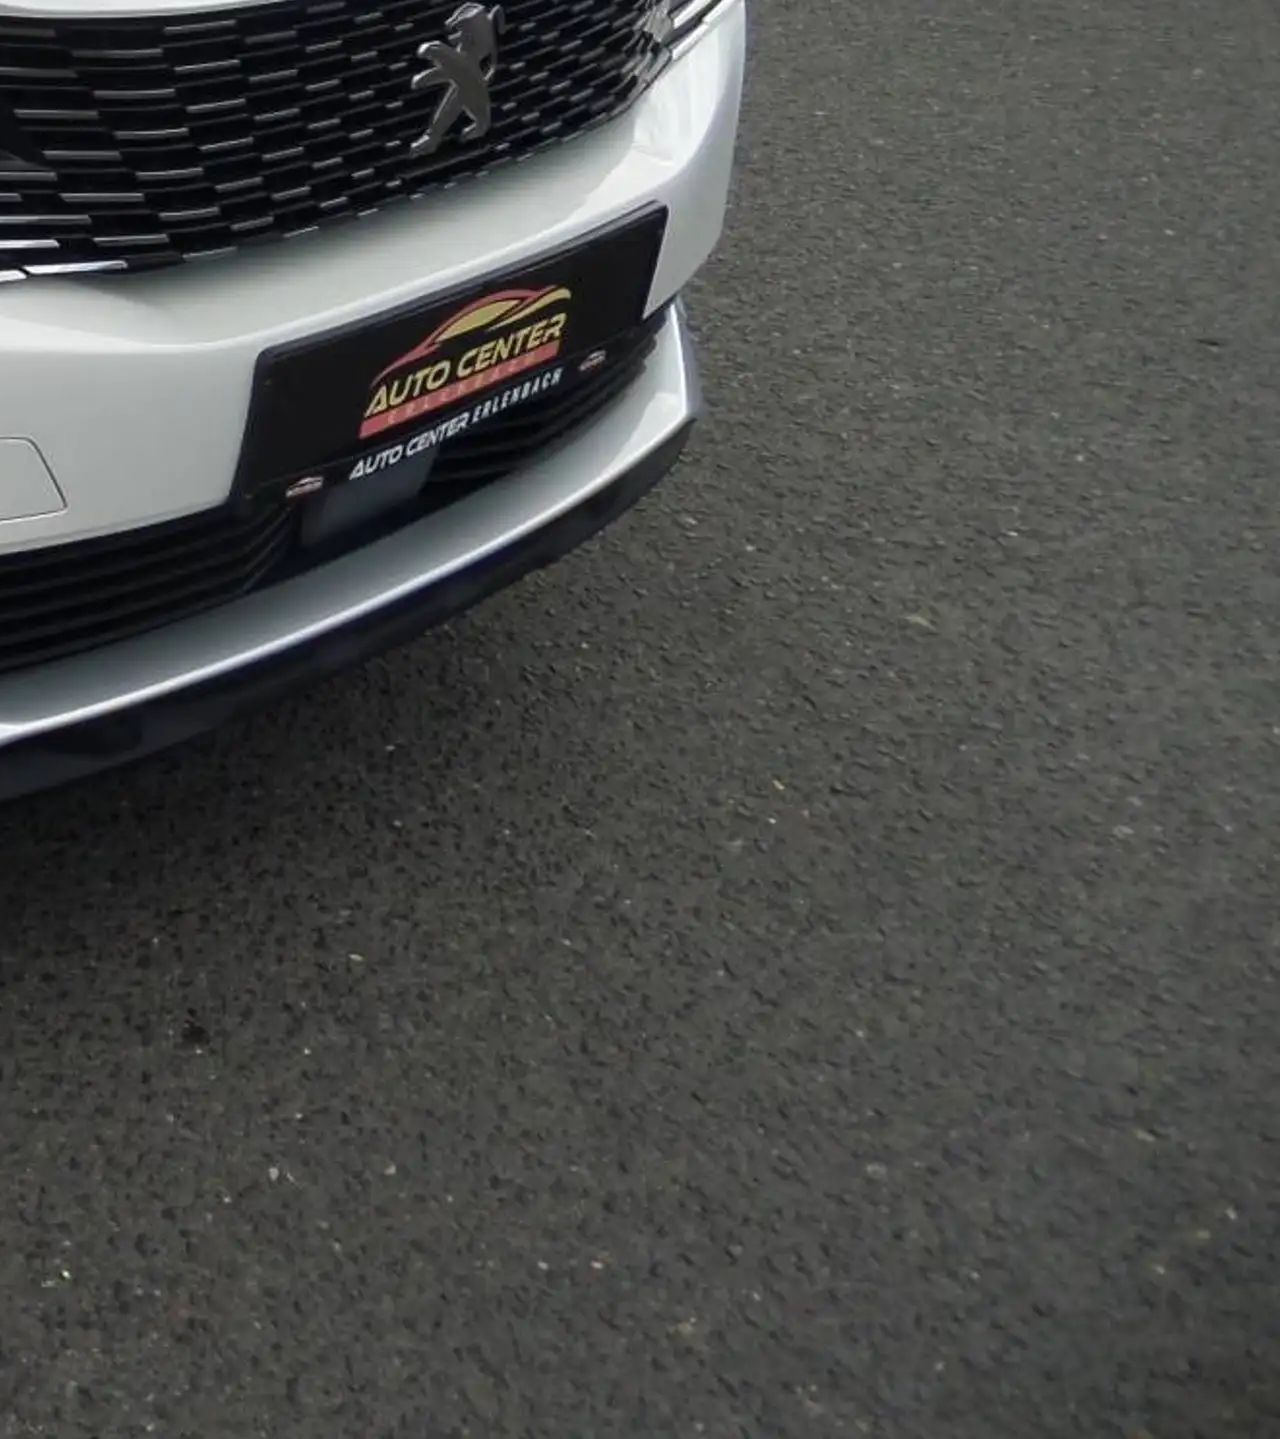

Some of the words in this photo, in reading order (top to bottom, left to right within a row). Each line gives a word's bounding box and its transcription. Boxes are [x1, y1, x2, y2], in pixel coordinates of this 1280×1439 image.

[364, 358, 452, 418] AUTO
[456, 311, 568, 377] CENTER
[348, 444, 402, 481] AUTO
[405, 411, 471, 458] CENTER
[472, 367, 564, 424] ERLENBACH
